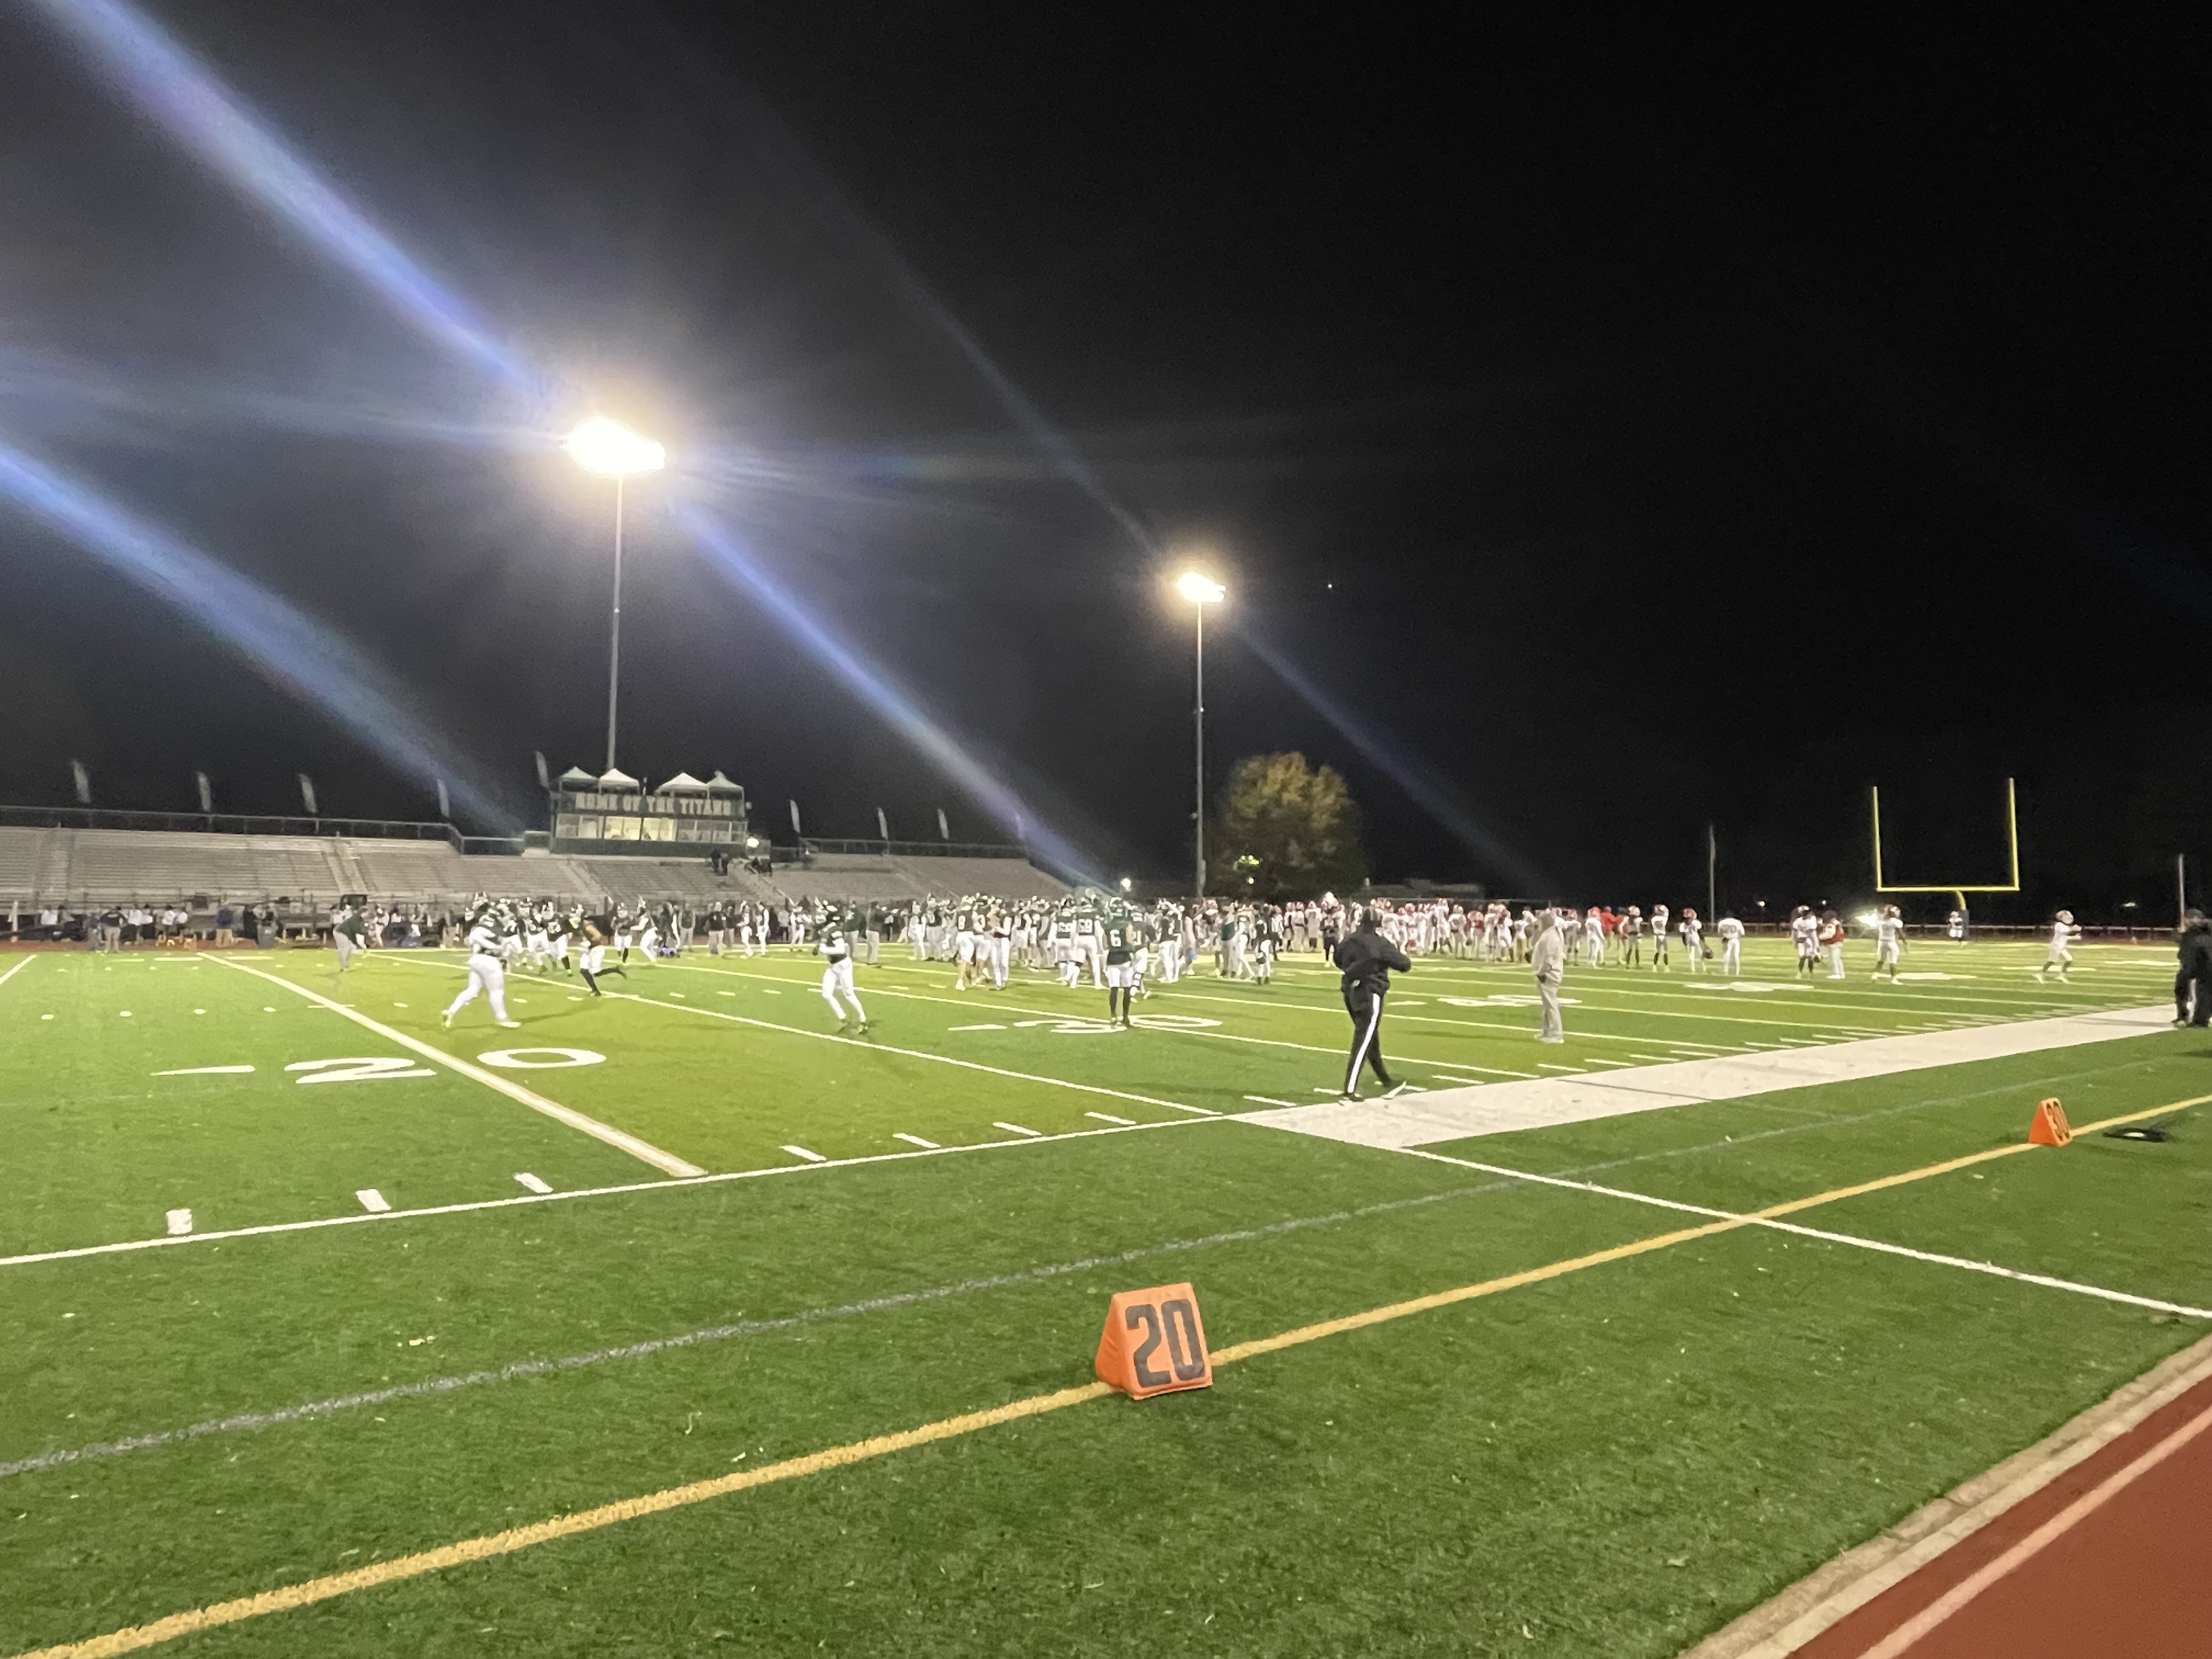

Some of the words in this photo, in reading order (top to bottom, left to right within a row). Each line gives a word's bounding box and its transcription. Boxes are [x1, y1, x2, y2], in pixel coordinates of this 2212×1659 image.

[1110, 929, 1121, 947] 6
[284, 1047, 607, 1084] 20
[1125, 1299, 1206, 1388] 20
